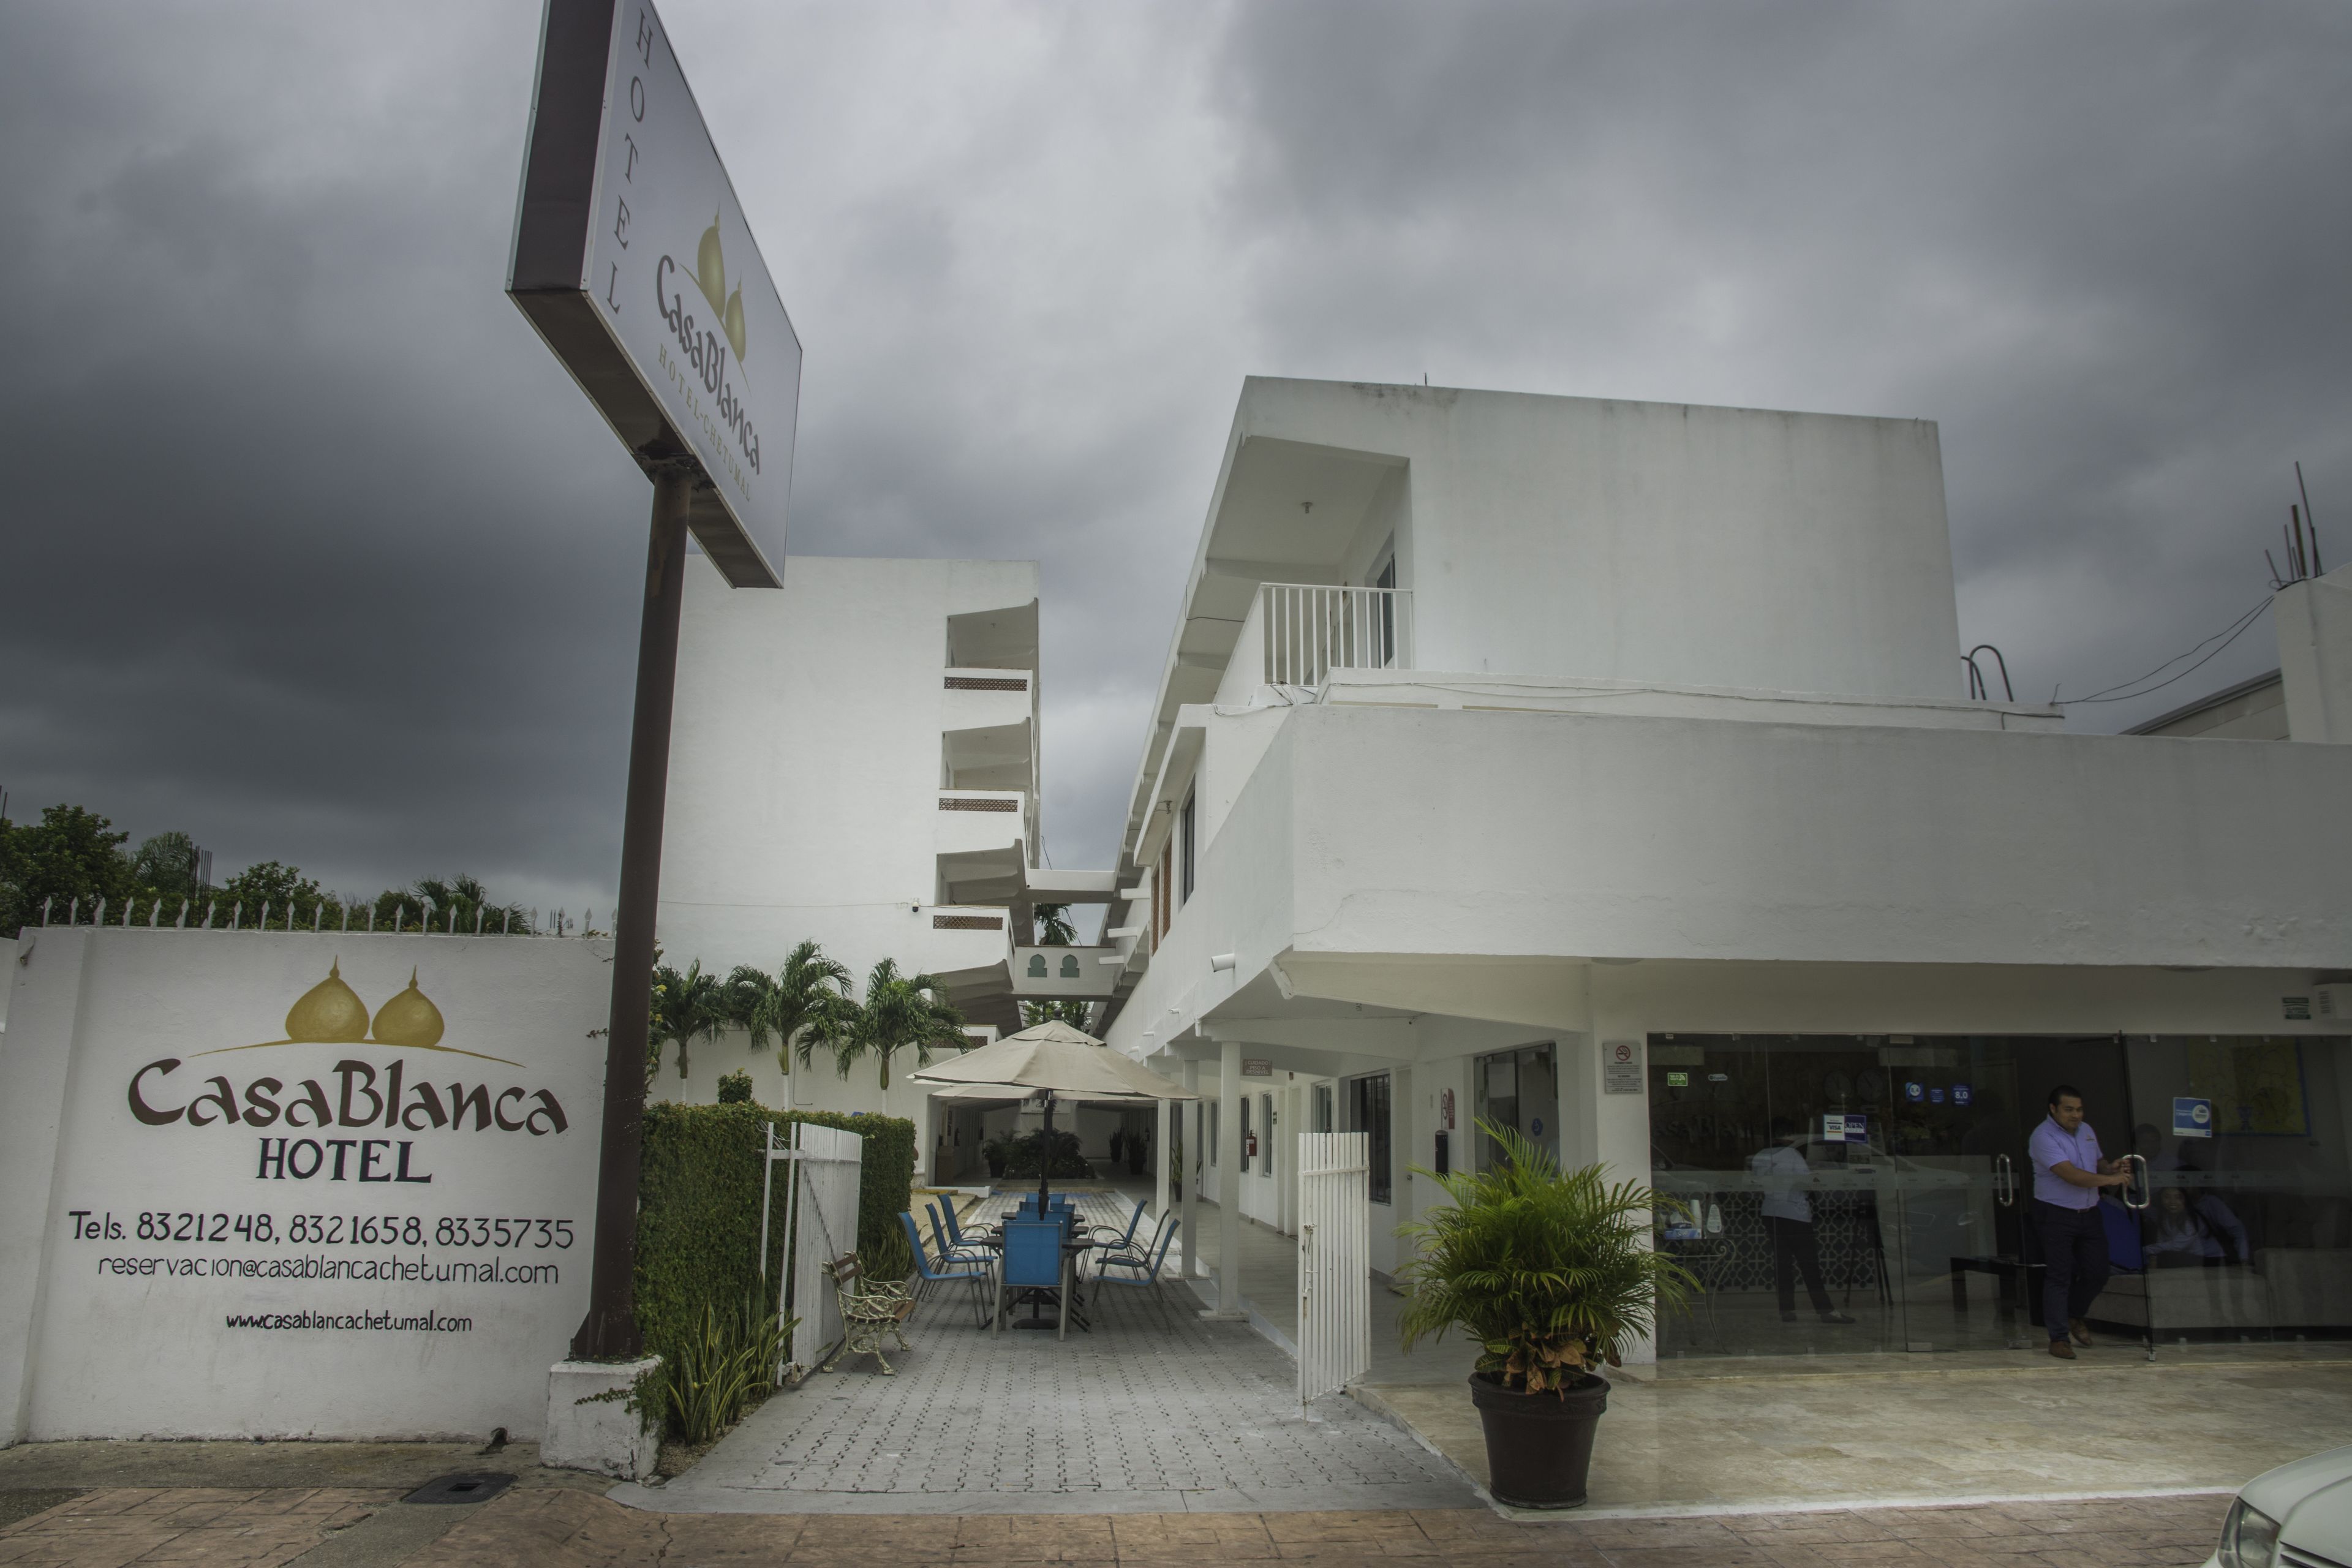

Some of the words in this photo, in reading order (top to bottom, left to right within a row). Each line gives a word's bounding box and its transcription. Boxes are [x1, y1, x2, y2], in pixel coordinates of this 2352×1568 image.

[606, 7, 654, 315] HOTEL
[656, 254, 760, 476] CasaBlanca
[127, 1058, 569, 1136] CasaBlanca
[255, 1137, 432, 1183] HOTEL
[69, 1210, 127, 1241] Tels.
[137, 1212, 280, 1245] 8321248,
[289, 1215, 428, 1248] 8321658,
[435, 1217, 575, 1250] 8335735
[225, 1309, 473, 1333] www.casablancachetumal.com
